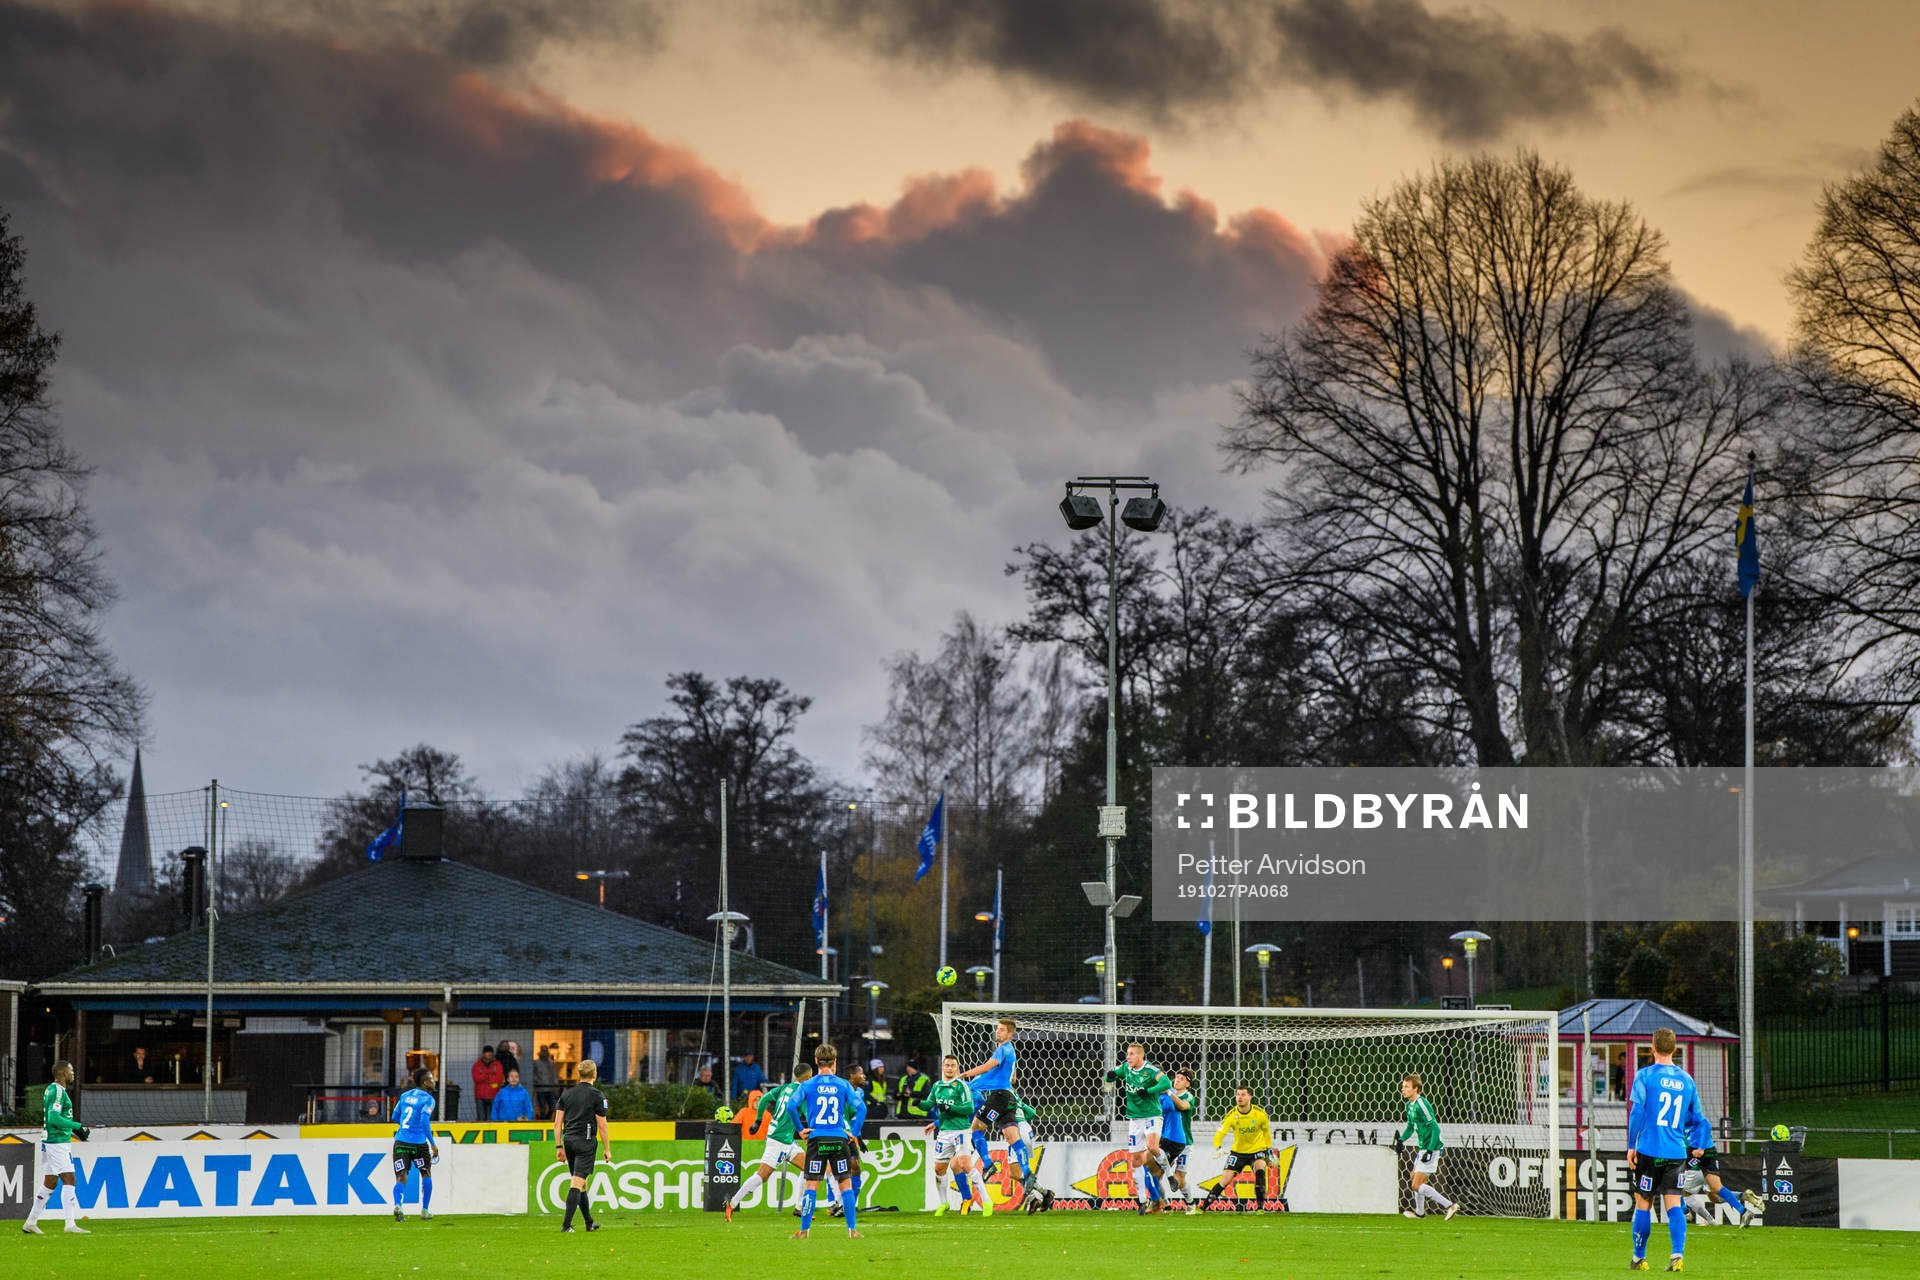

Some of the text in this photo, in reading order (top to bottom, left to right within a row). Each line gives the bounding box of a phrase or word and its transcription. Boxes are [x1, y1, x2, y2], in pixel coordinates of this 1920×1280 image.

[402, 1106, 413, 1129] 2
[815, 1096, 839, 1125] 23
[1656, 1091, 1683, 1128] 21
[713, 1175, 739, 1183] OBOS
[1489, 1156, 1630, 1190] OFFICE
[1772, 1195, 1798, 1203] OBOS
